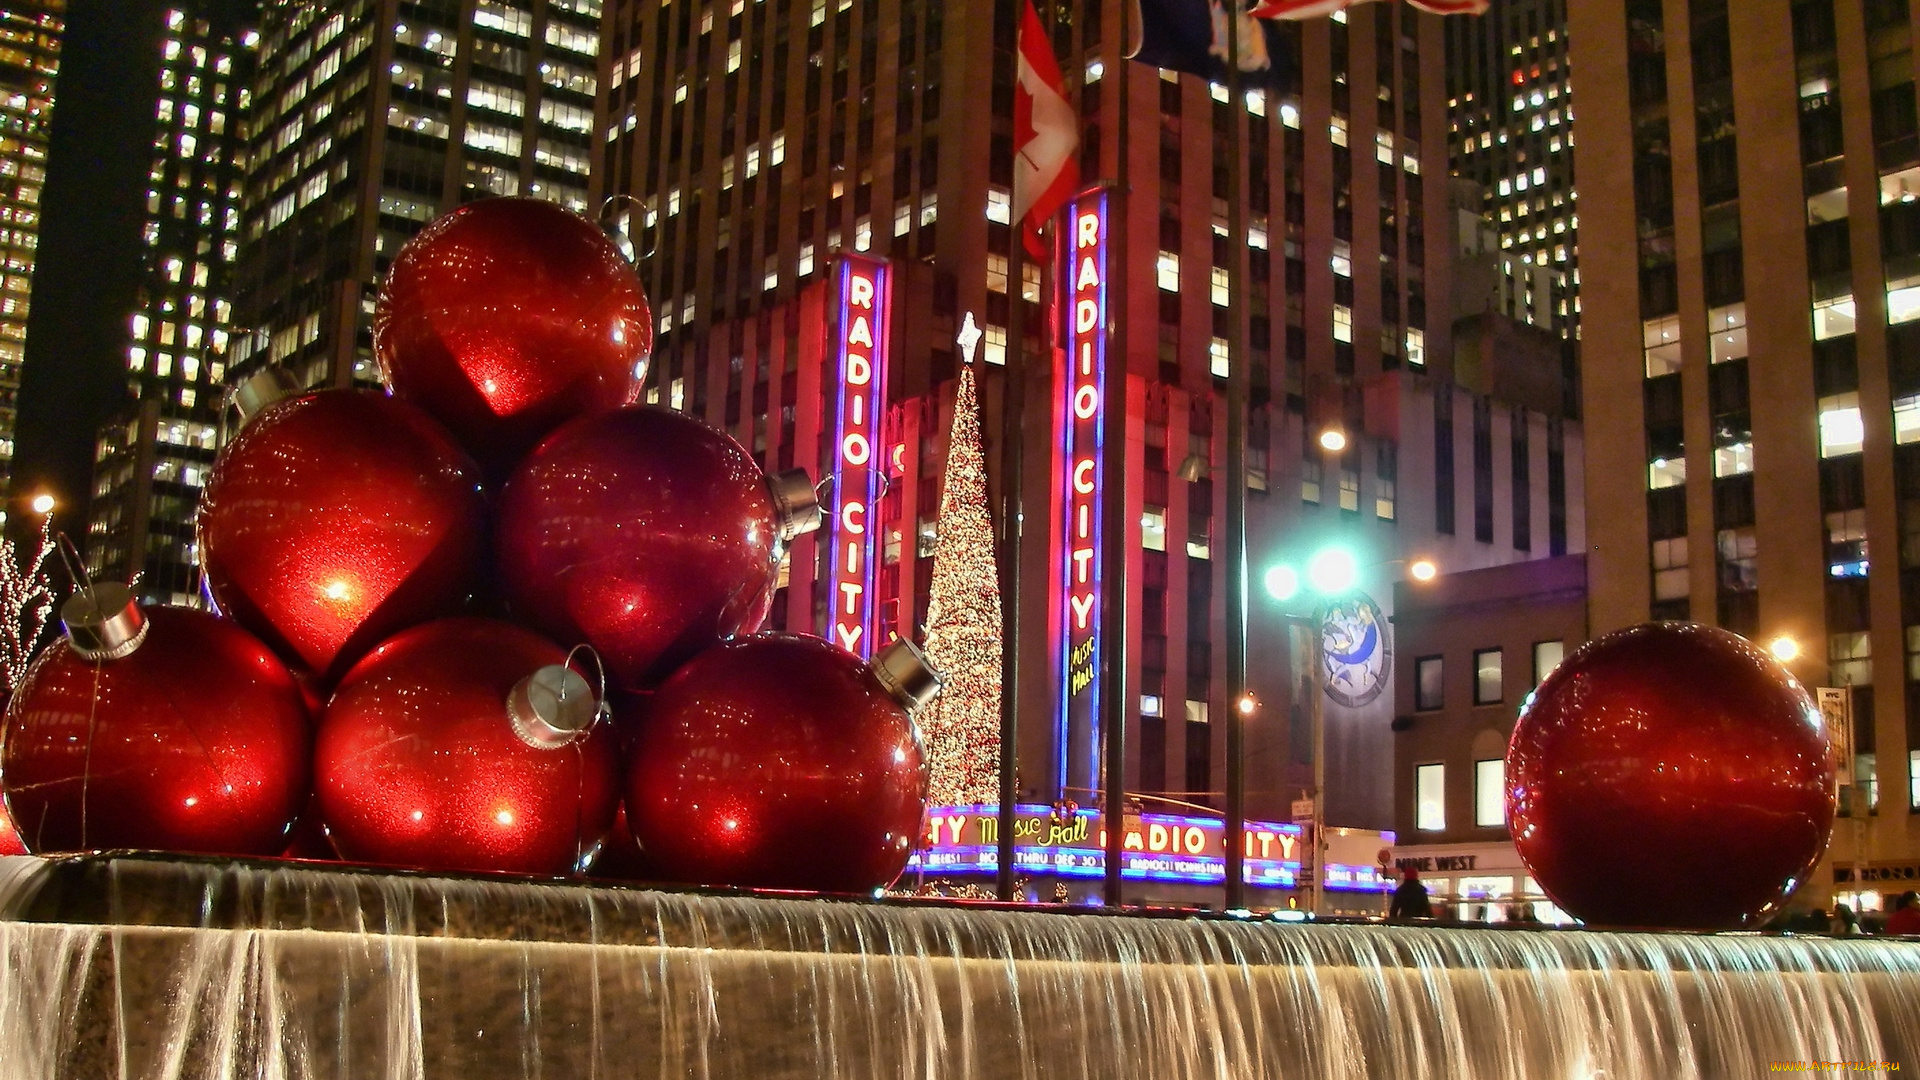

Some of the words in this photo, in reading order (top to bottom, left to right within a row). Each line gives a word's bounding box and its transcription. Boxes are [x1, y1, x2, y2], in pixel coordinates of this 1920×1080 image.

[1074, 213, 1100, 420] RADIO
[843, 275, 875, 466] RADIO
[837, 501, 865, 652] CITY
[1070, 459, 1095, 629] CITY
[1070, 636, 1095, 672] MUSIC
[977, 817, 1042, 845] Msic
[1222, 831, 1296, 860] ITY
[1015, 852, 1048, 865] THRU
[1054, 854, 1076, 867] DEC
[1082, 856, 1097, 867] 30
[1395, 856, 1432, 871] NINE
[1435, 855, 1478, 871] WEST
